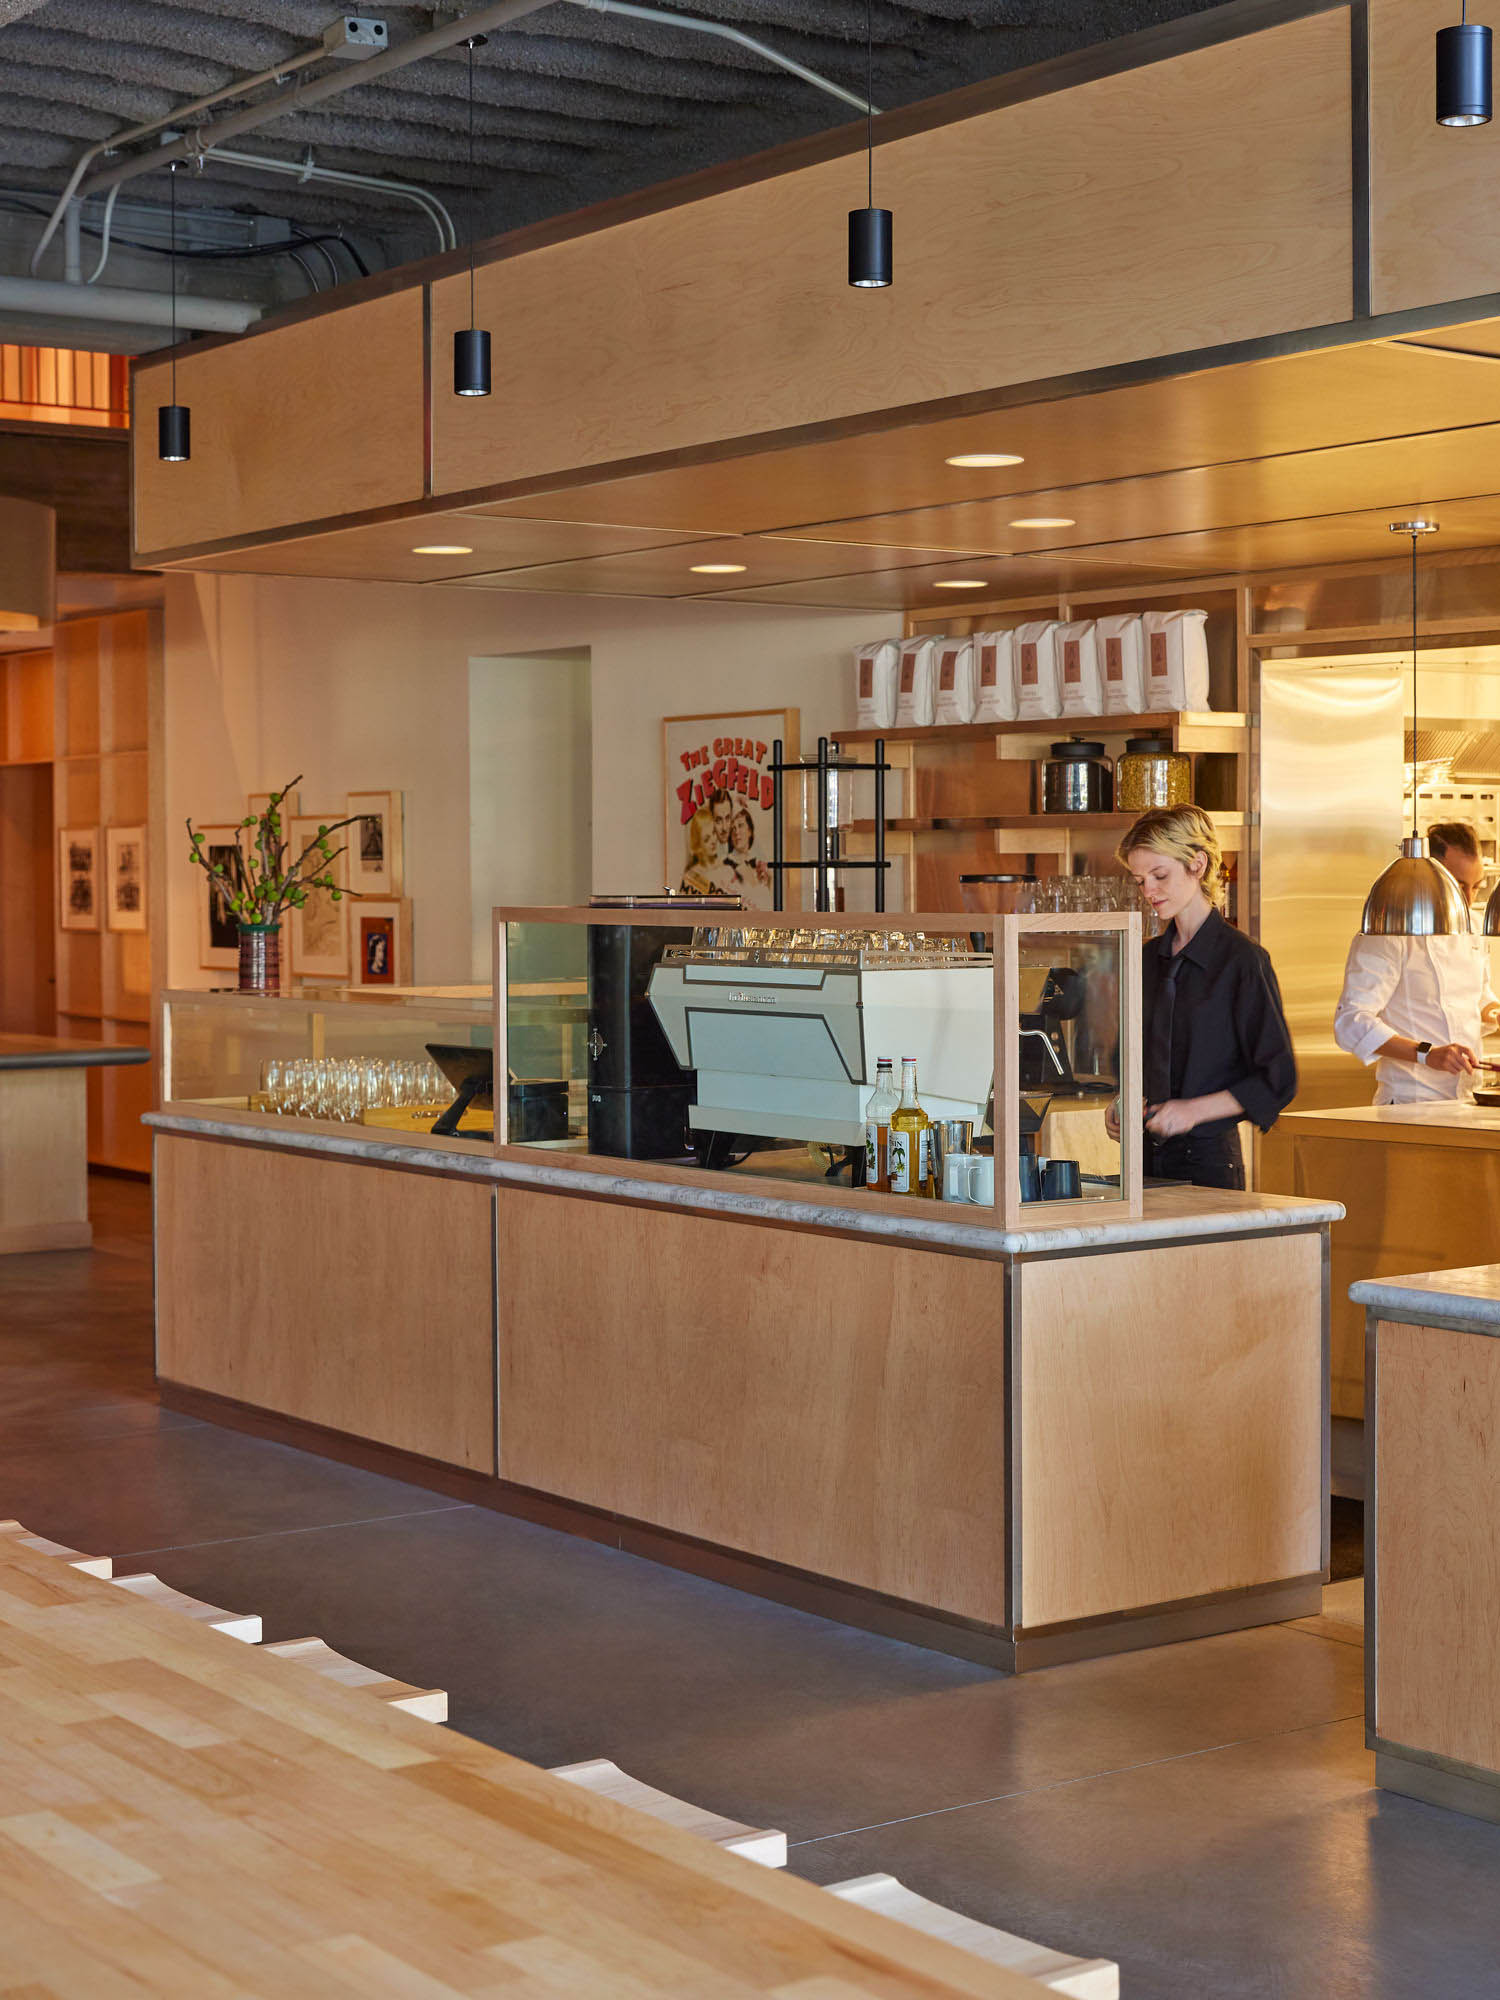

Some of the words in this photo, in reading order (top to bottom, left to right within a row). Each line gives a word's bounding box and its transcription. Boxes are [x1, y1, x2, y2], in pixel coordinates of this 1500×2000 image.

[680, 745, 710, 772] THE
[713, 737, 768, 764] GREAT
[676, 757, 775, 825] ZIEGFELD
